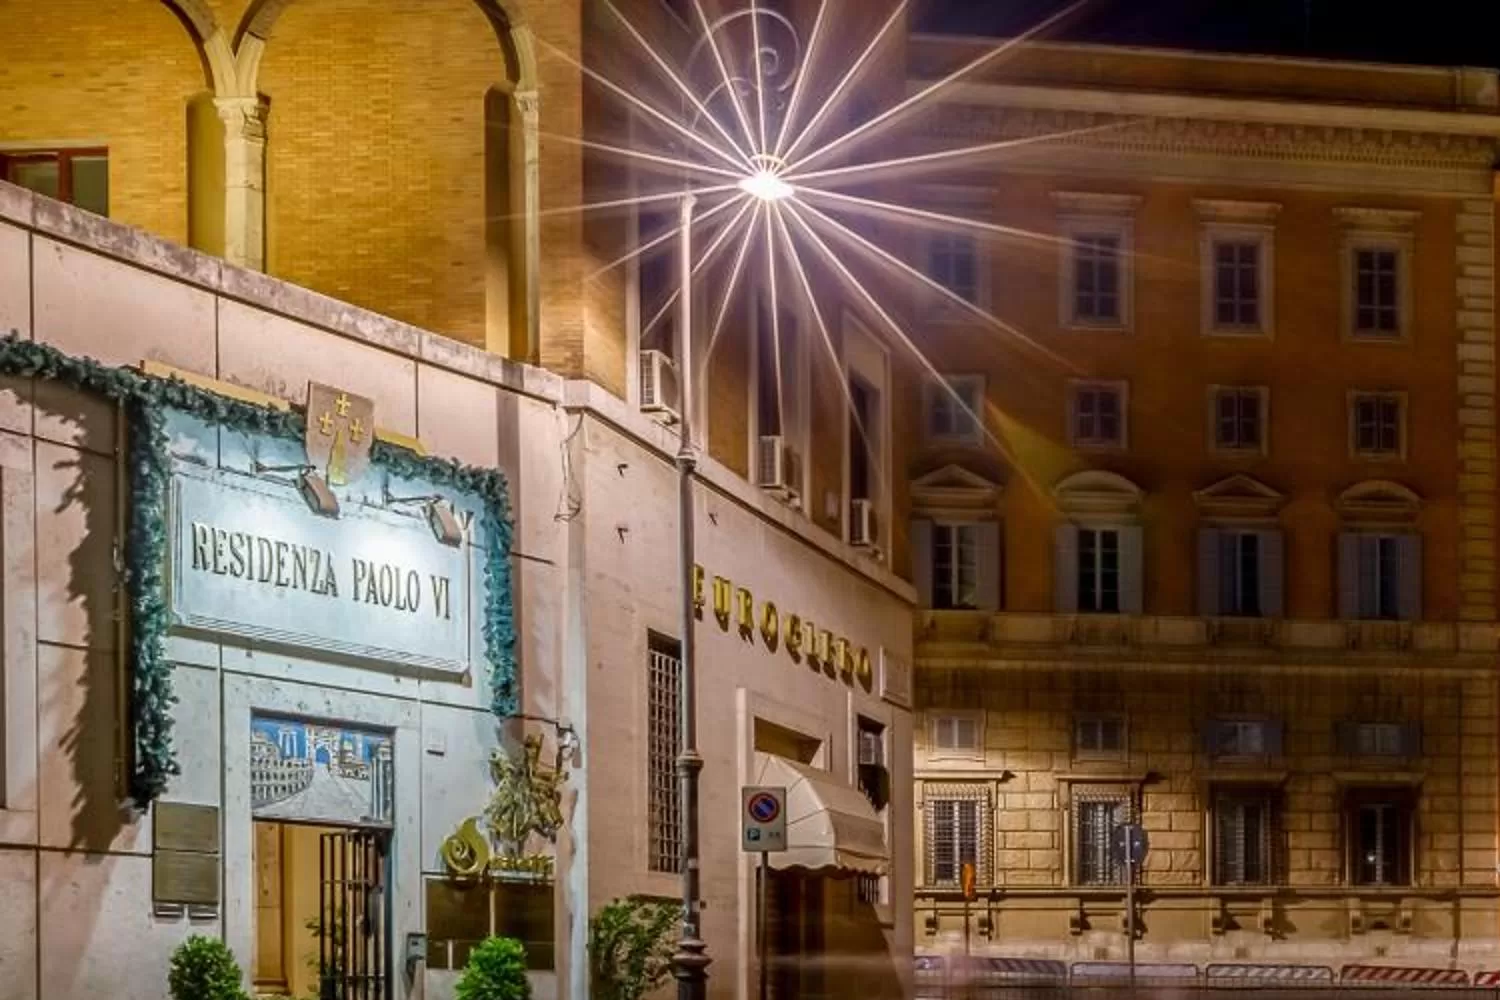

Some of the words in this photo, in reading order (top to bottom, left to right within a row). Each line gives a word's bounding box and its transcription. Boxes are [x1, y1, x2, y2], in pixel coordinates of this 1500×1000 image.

[191, 522, 339, 598] RESIDENZA
[351, 558, 421, 613] PAOLO
[430, 574, 452, 620] VI
